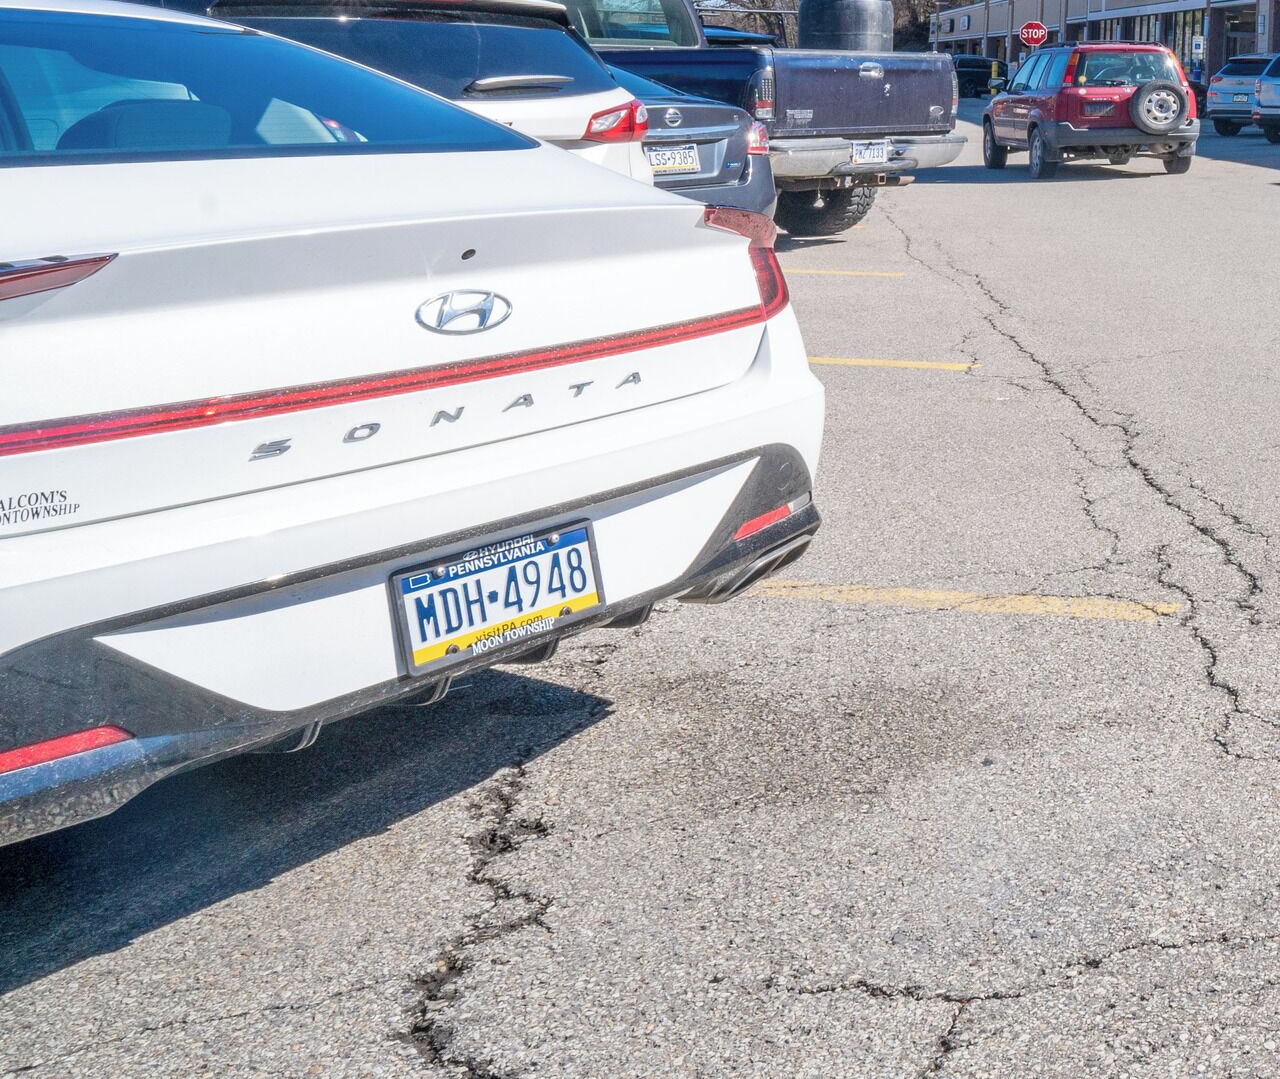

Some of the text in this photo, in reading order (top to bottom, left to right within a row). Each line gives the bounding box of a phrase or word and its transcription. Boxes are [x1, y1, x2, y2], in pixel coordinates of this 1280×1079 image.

[1021, 29, 1046, 39] STOP
[248, 371, 642, 462] SONATA
[448, 541, 545, 578] PENNSYLVANIA
[479, 534, 535, 557] HYUNDAI
[471, 616, 556, 656] MOON TOWNSHIP
